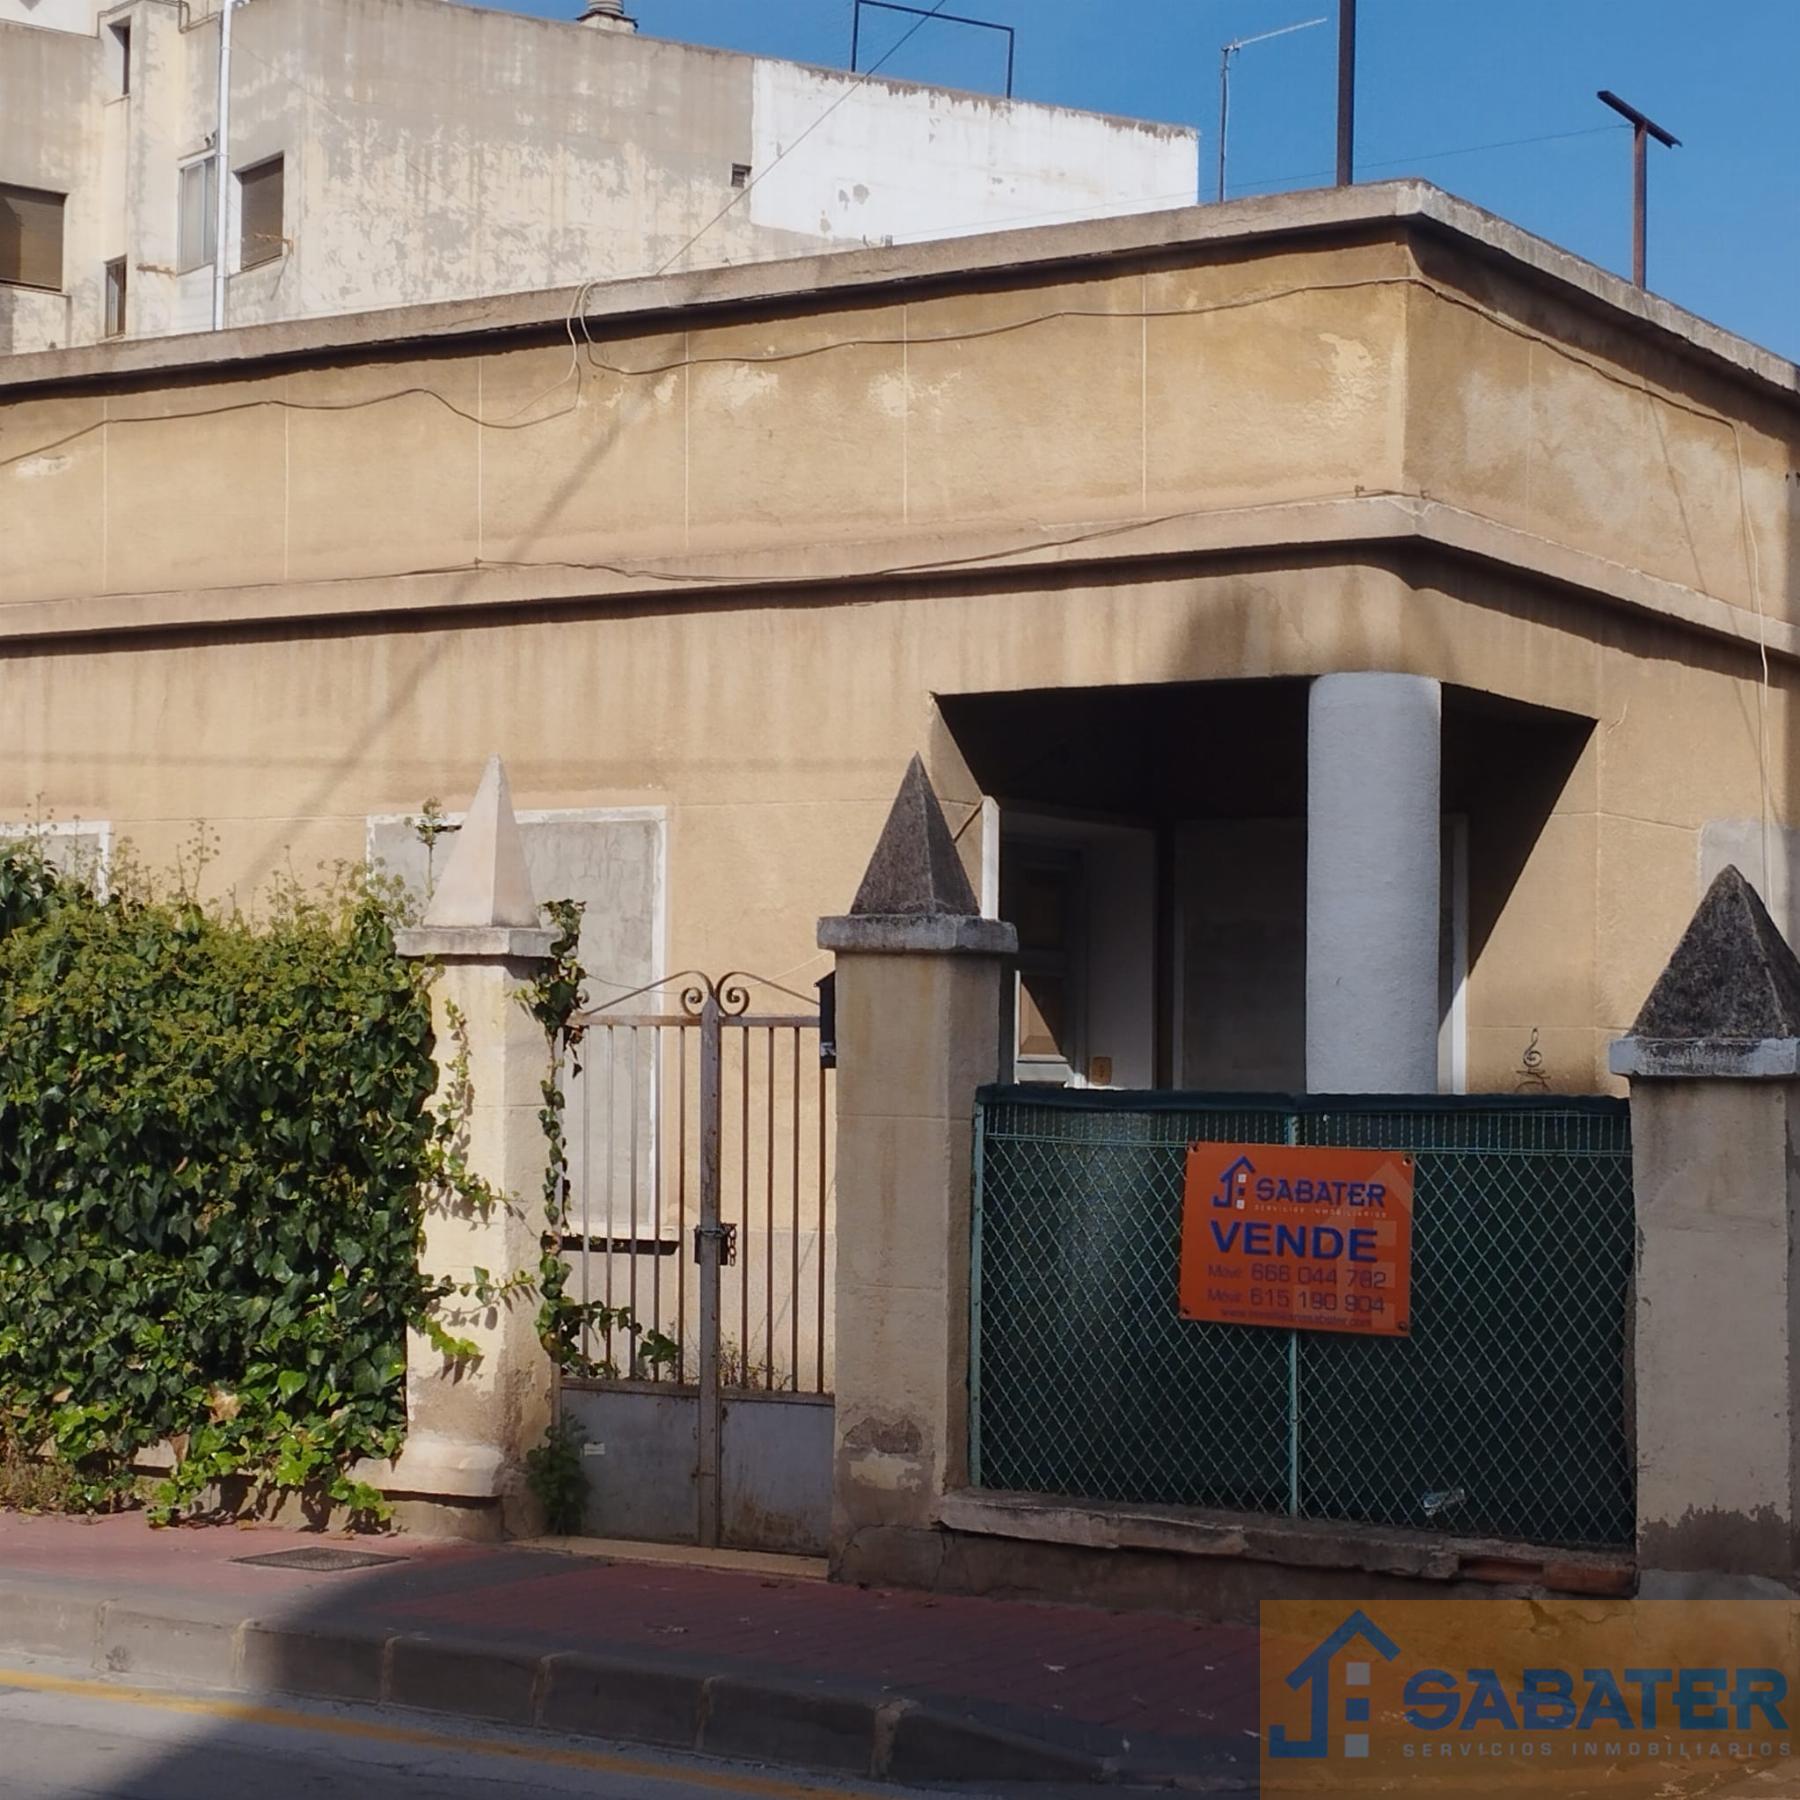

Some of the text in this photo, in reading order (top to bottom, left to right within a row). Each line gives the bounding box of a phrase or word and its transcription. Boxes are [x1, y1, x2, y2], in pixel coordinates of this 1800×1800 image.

[1255, 1177, 1386, 1208] SABATER
[1210, 1220, 1378, 1263] VENDE
[1251, 1263, 1291, 1283] 666
[1297, 1266, 1337, 1286] 044
[1250, 1287, 1290, 1308] 615
